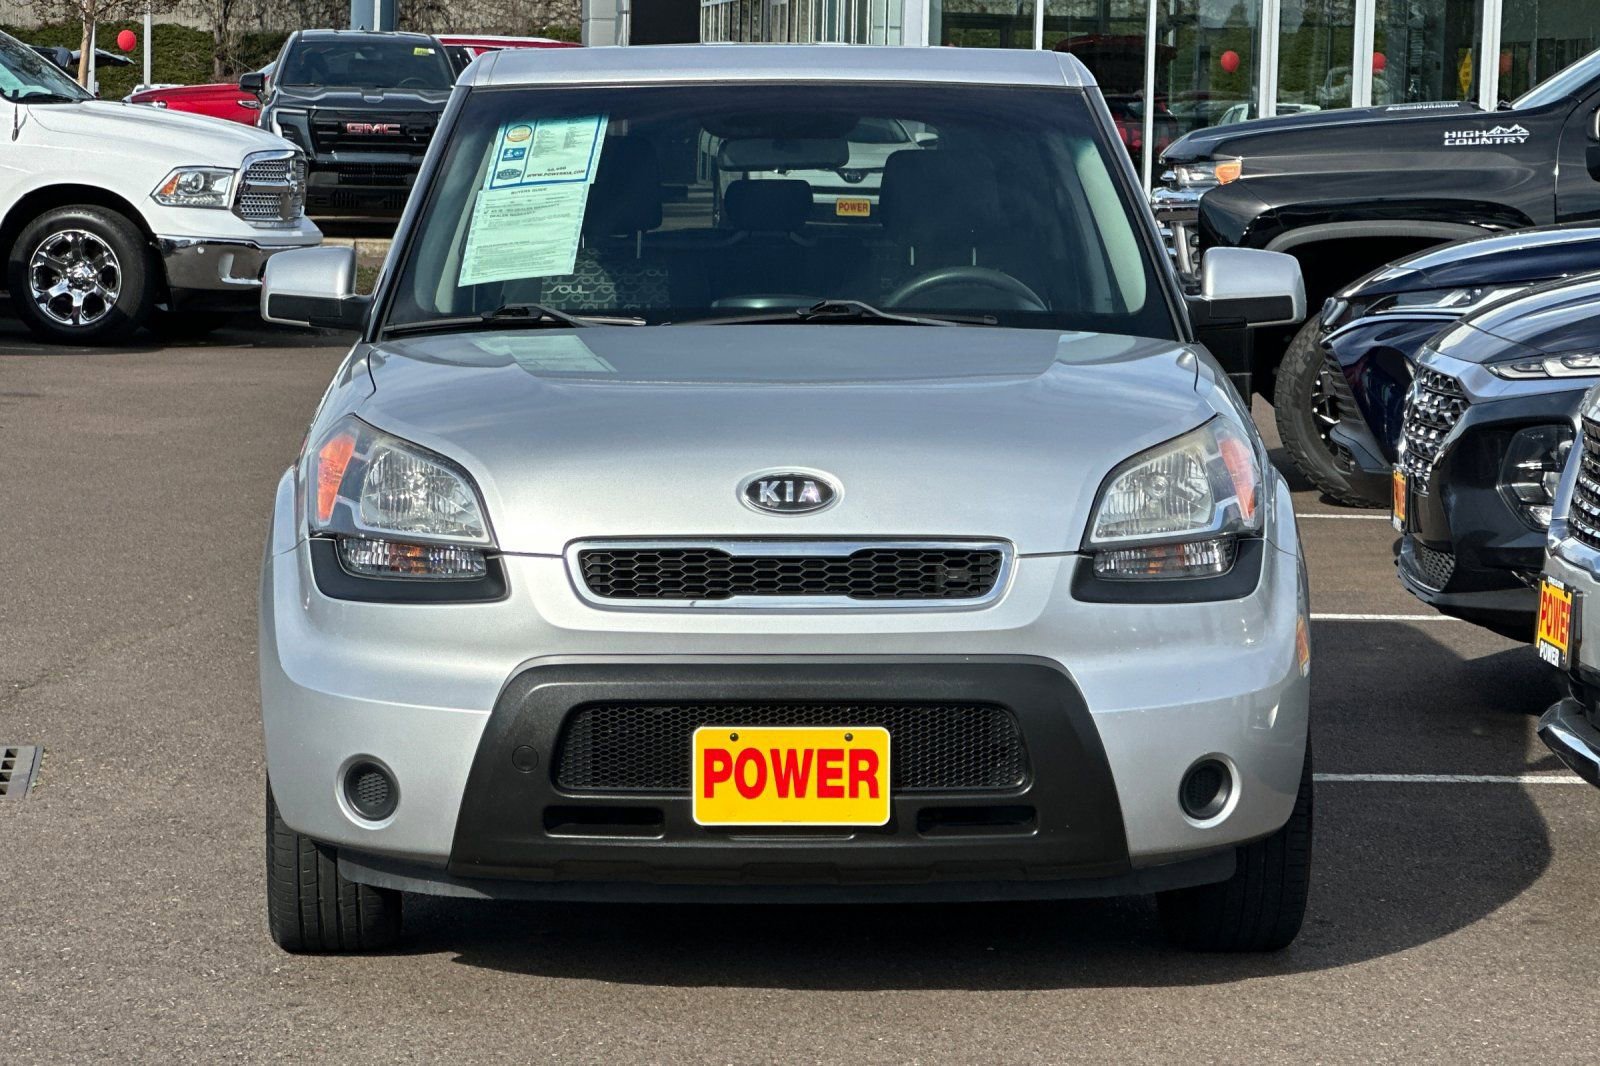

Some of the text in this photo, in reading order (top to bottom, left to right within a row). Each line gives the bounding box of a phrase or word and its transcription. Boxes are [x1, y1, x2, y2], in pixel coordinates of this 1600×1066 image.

[346, 123, 401, 134] GMC
[1443, 136, 1528, 146] COUNTRY
[838, 202, 868, 213] POWER
[758, 480, 822, 503] KIA
[703, 747, 880, 800] POWER
